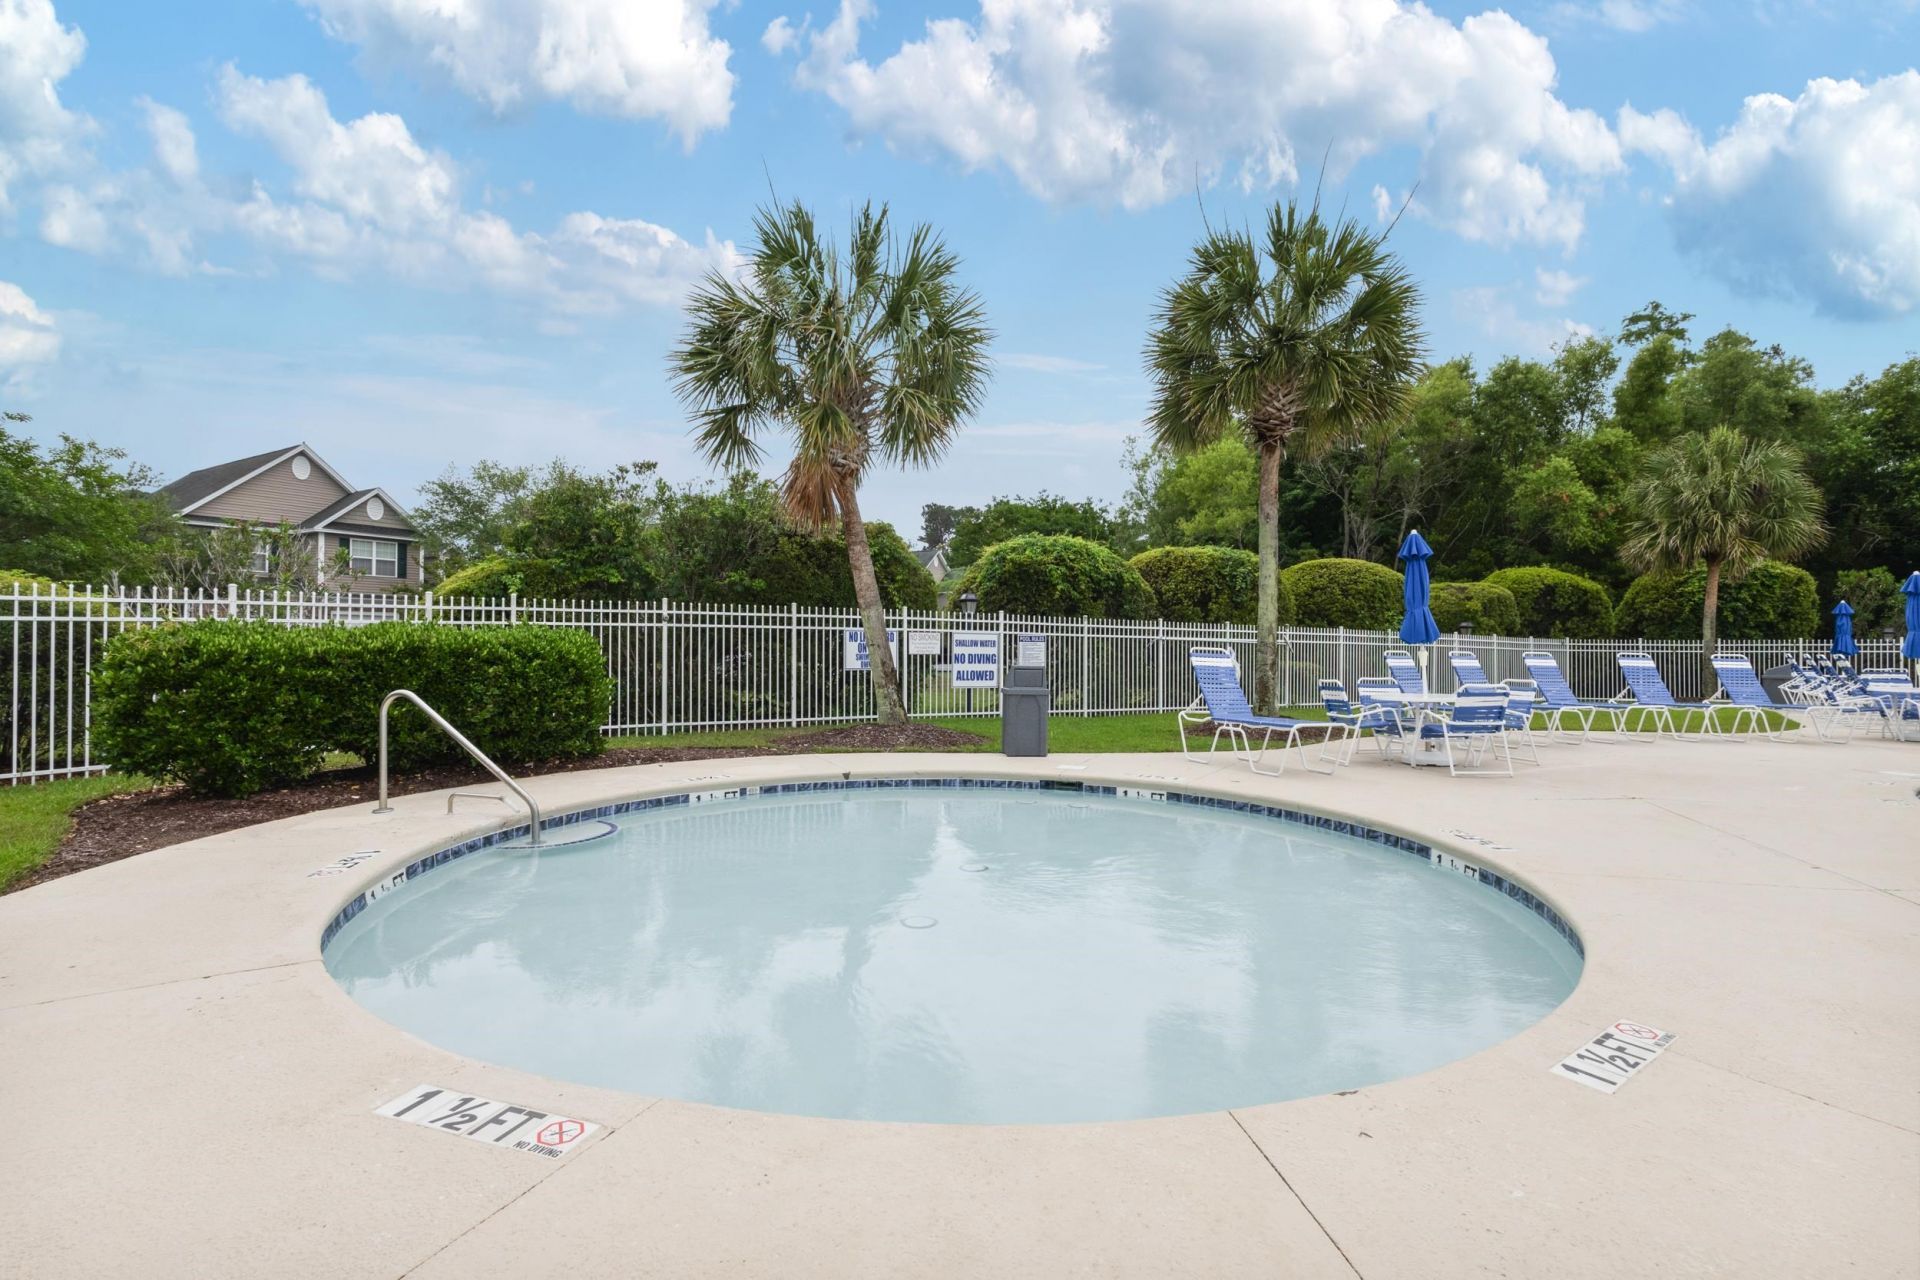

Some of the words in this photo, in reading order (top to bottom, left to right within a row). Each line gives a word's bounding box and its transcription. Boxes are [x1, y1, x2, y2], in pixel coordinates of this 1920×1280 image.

[849, 632, 858, 642] NO
[954, 653, 966, 664] NO
[968, 653, 997, 664] DIVING
[956, 670, 995, 681] ALLOWED
[1561, 1063, 1617, 1086] 1
[1592, 1032, 1657, 1061] FT
[393, 1089, 444, 1117] 1
[467, 1105, 548, 1143] FT
[512, 1140, 530, 1149] NO
[528, 1144, 563, 1158] DIVING
